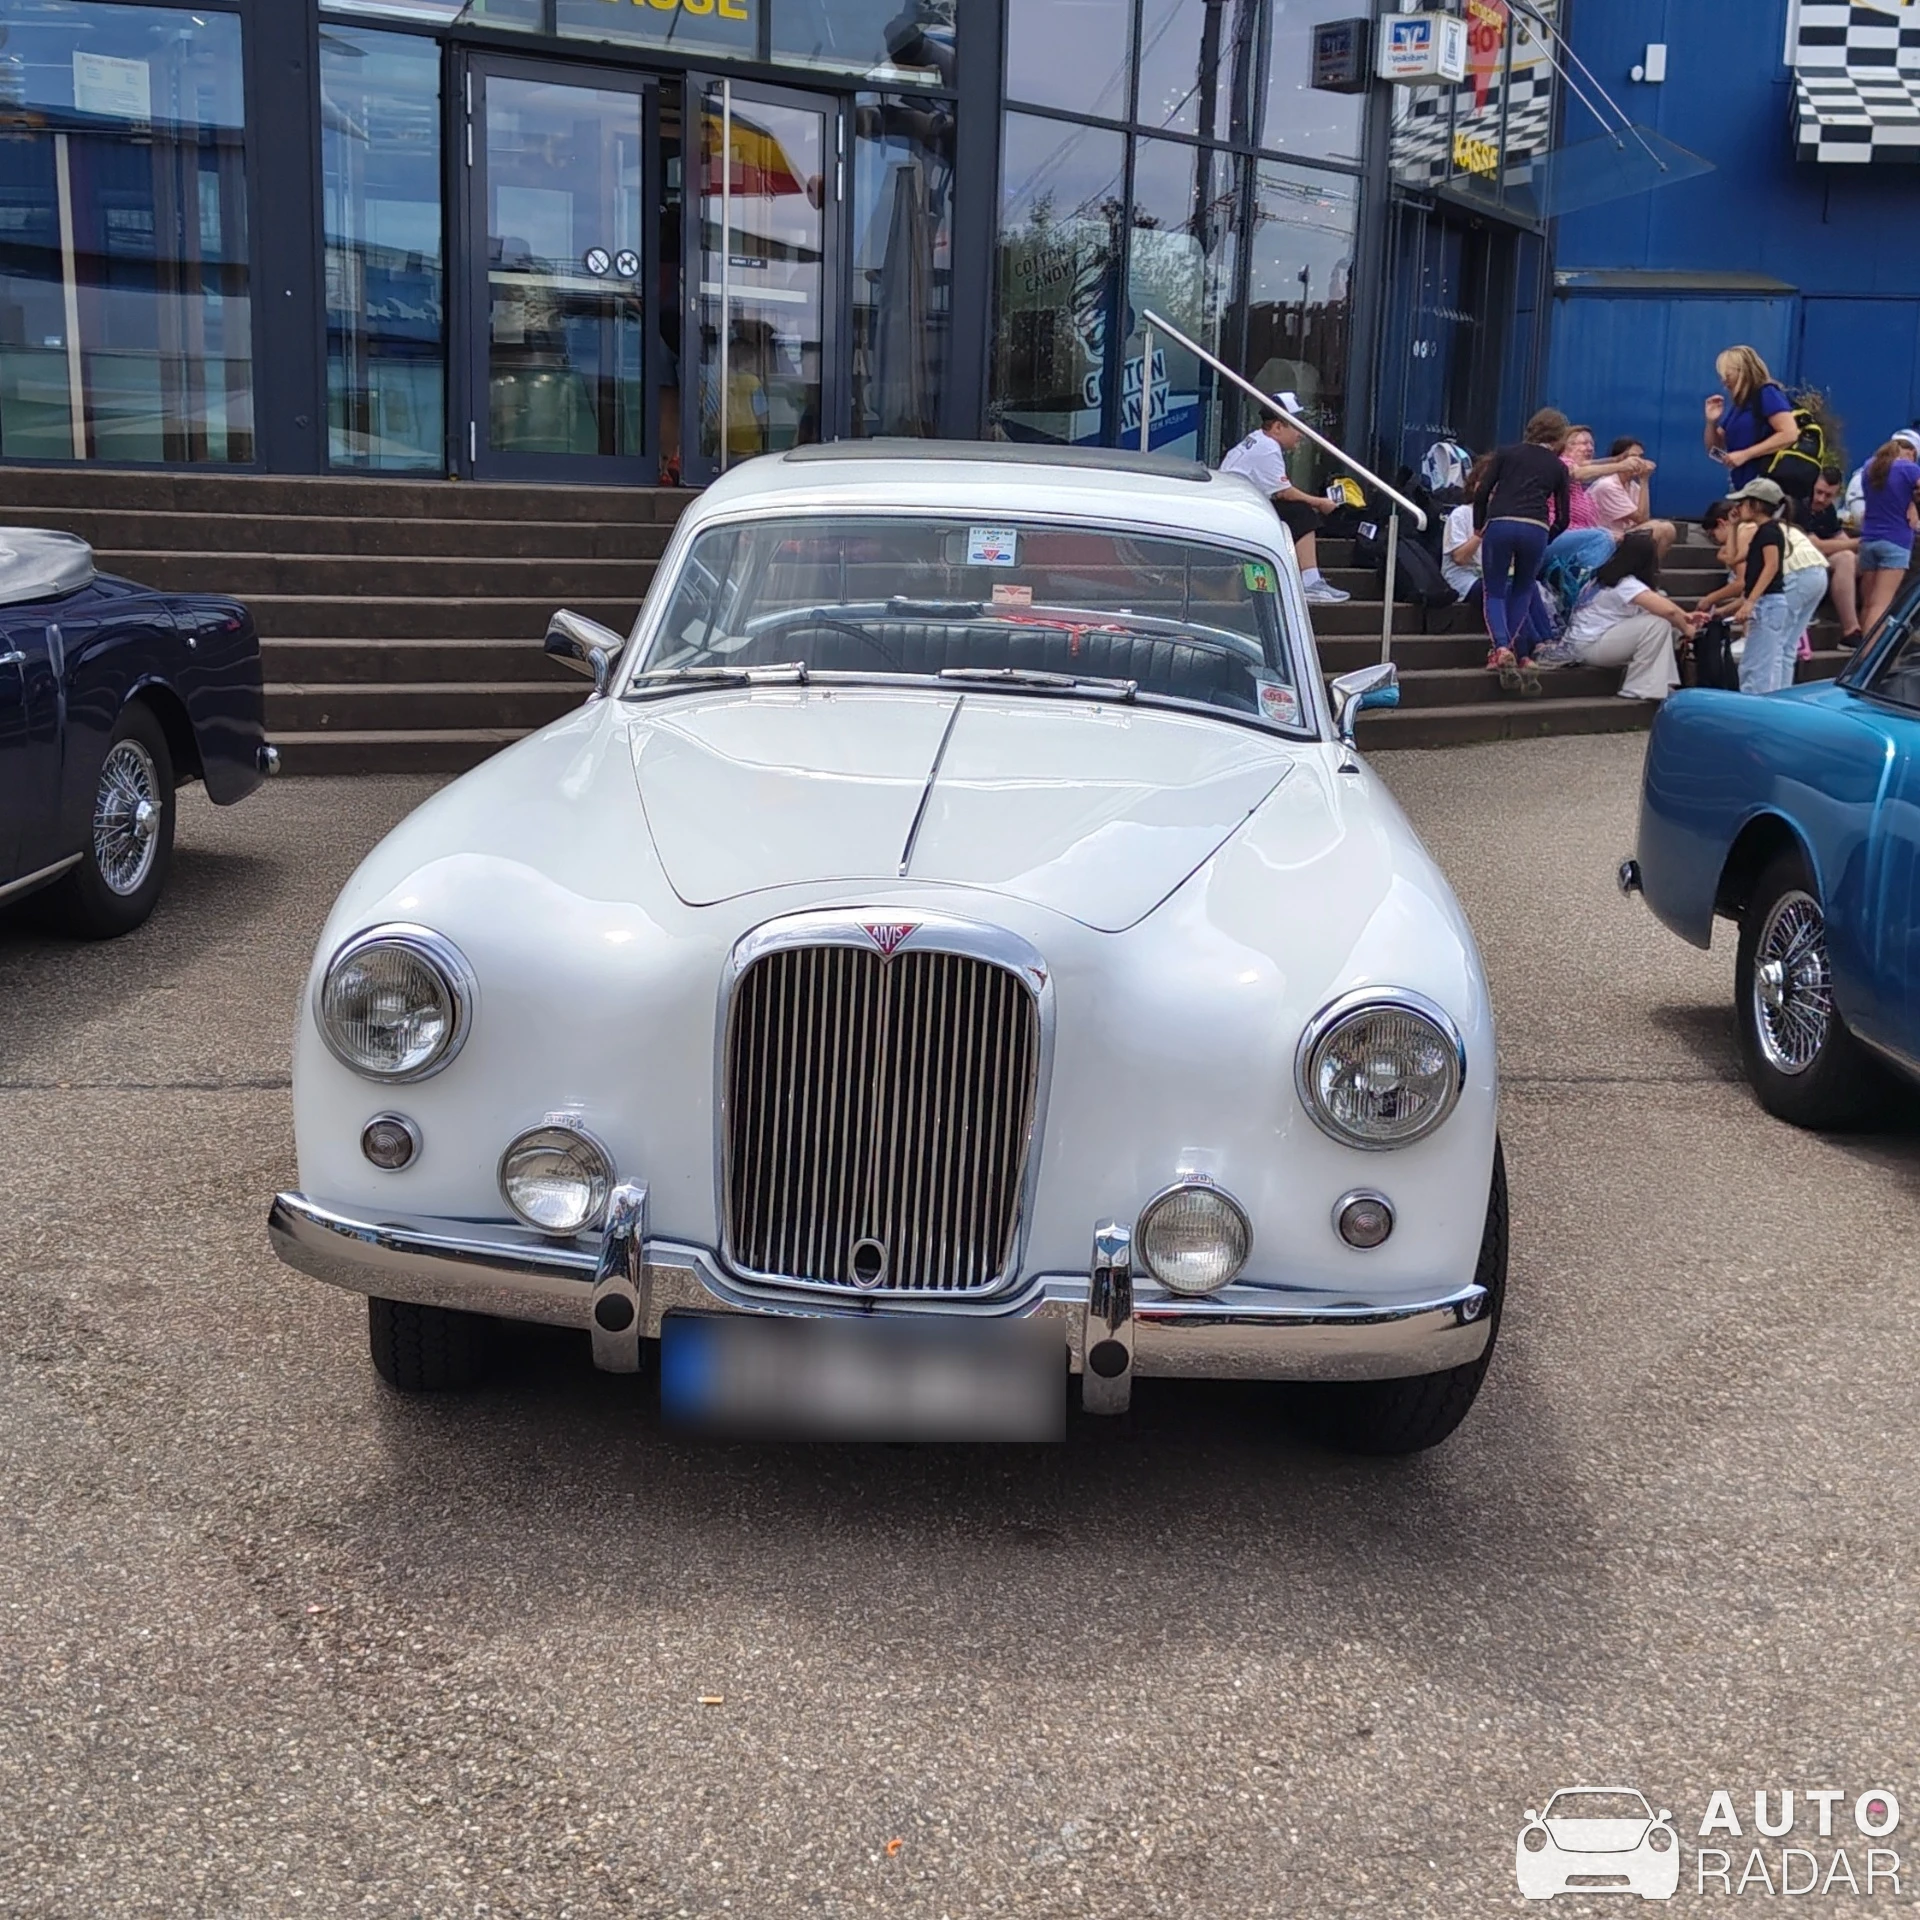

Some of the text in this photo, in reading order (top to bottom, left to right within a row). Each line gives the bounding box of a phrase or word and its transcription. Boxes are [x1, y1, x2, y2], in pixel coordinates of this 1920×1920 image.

[1453, 132, 1499, 173] KASSE
[1026, 261, 1069, 293] CANDY
[872, 925, 904, 949] ALVIS
